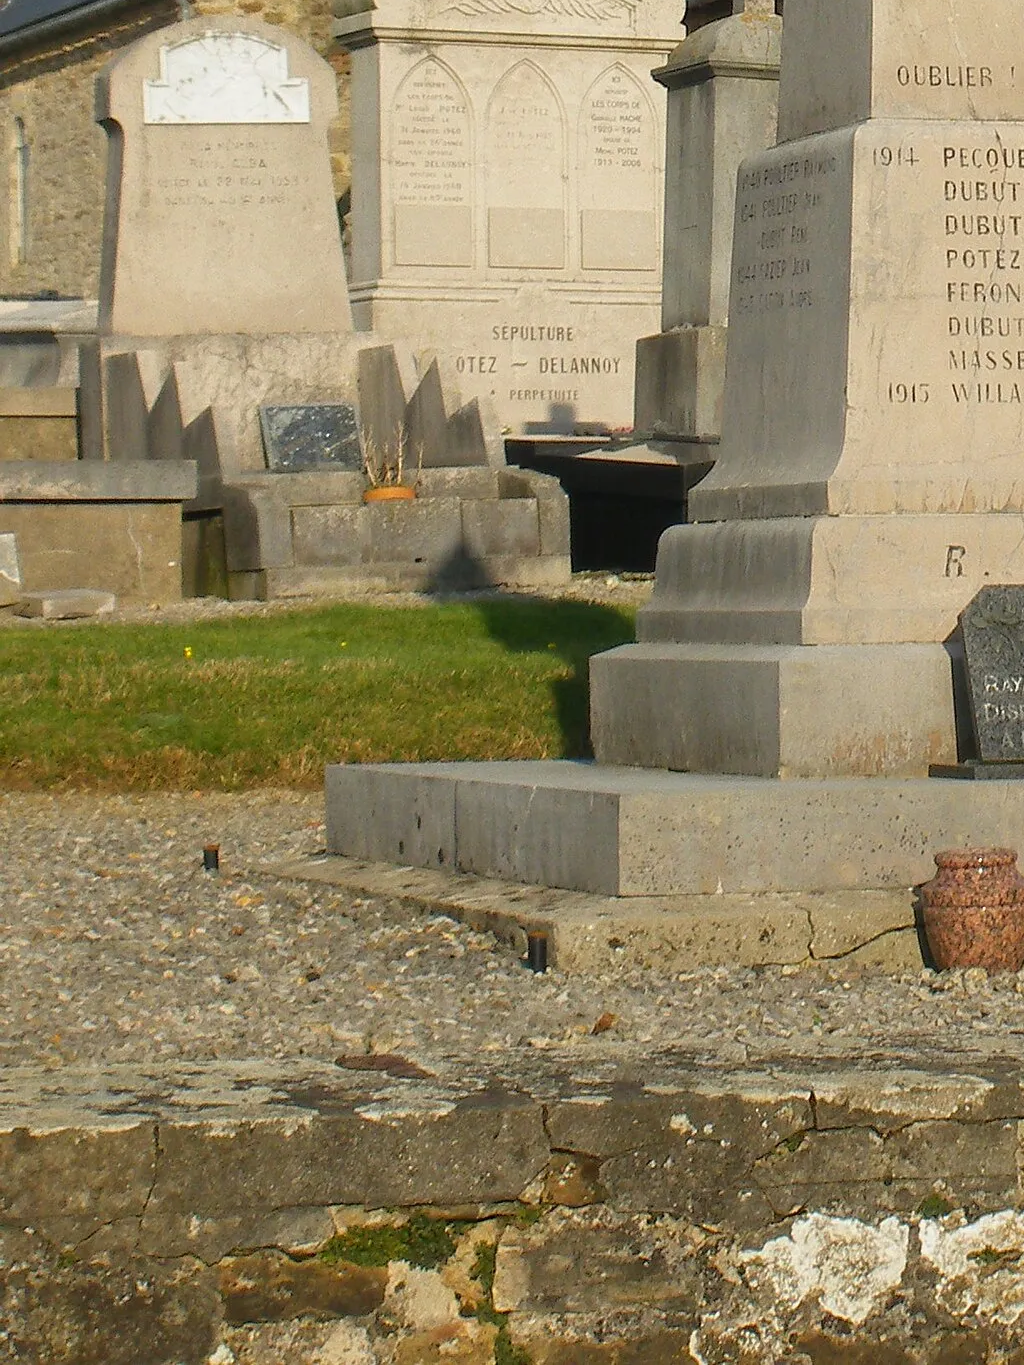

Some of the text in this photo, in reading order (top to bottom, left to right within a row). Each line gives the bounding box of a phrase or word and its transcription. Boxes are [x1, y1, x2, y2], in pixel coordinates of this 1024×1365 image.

[897, 65, 993, 87] OUBLIER
[872, 148, 920, 167] 1914
[944, 181, 1021, 202] DUBUT
[944, 215, 1023, 236] DUBUT
[946, 249, 1021, 270] POTEZ
[947, 282, 1022, 303] FERON
[537, 356, 622, 377] DELANNOY
[887, 383, 930, 403] 1915
